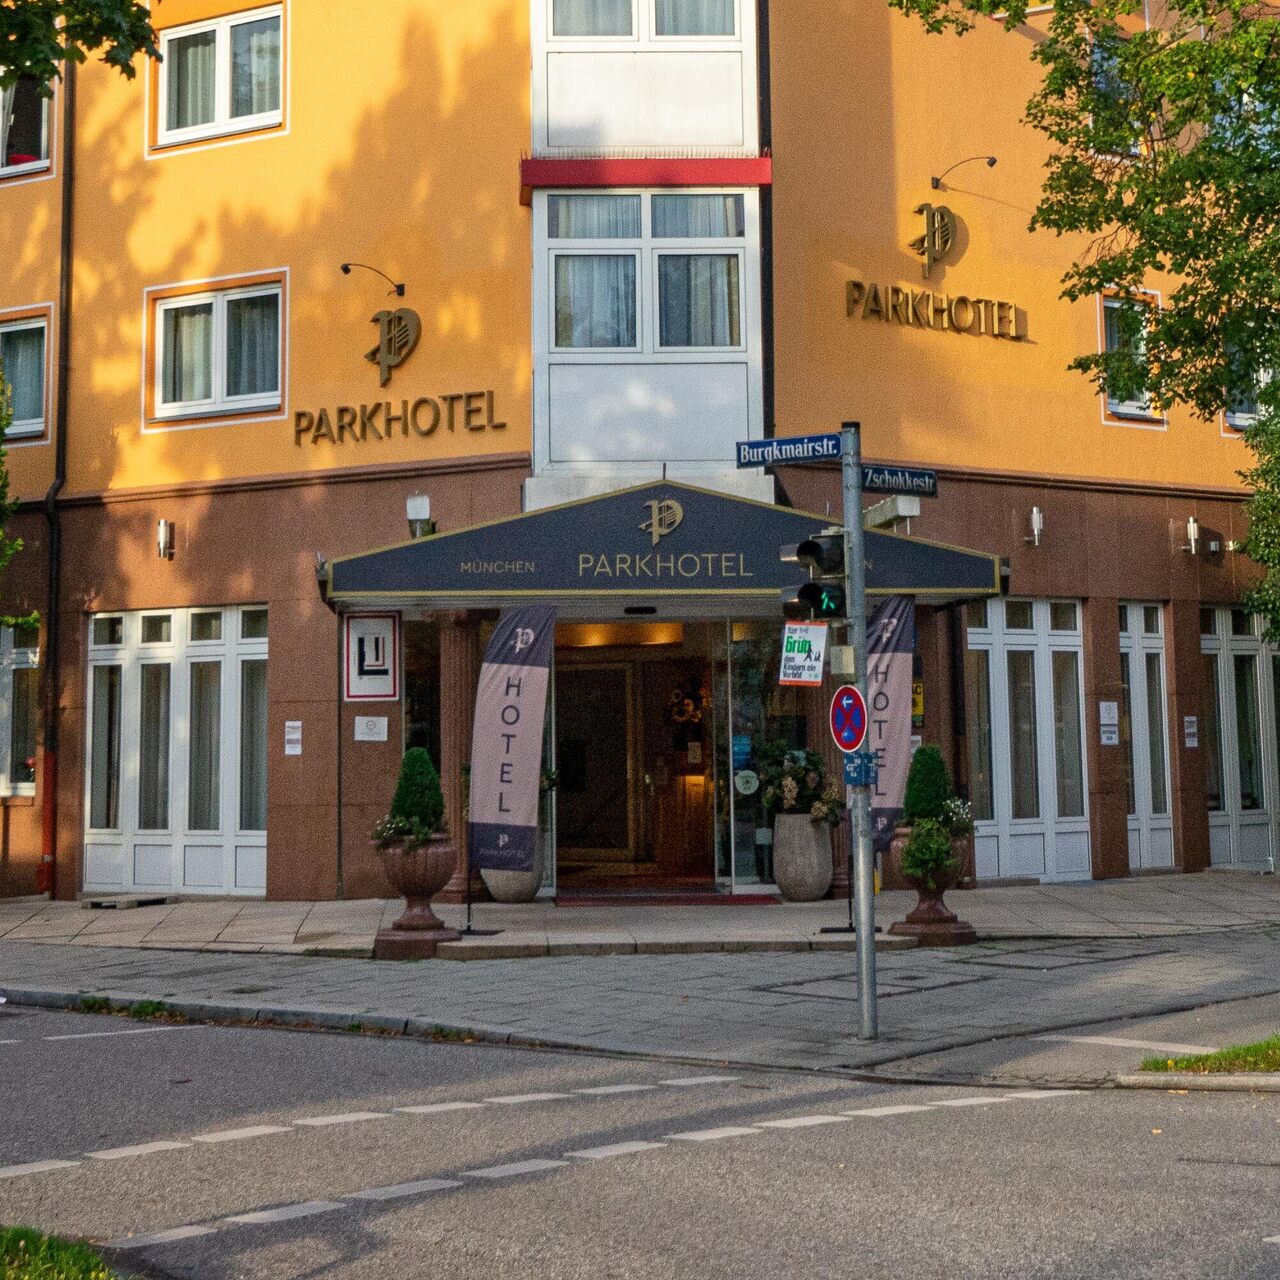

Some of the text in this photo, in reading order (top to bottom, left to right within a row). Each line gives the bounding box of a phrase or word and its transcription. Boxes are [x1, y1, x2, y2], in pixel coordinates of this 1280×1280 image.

[845, 280, 1028, 340] PARKHOTEL
[294, 390, 507, 448] PARKHOTEL
[740, 439, 838, 464] Burgkmairstr.
[460, 560, 535, 574] MÜNCHEN
[578, 553, 754, 577] PARKHOTEL
[498, 676, 522, 813] HOTEL
